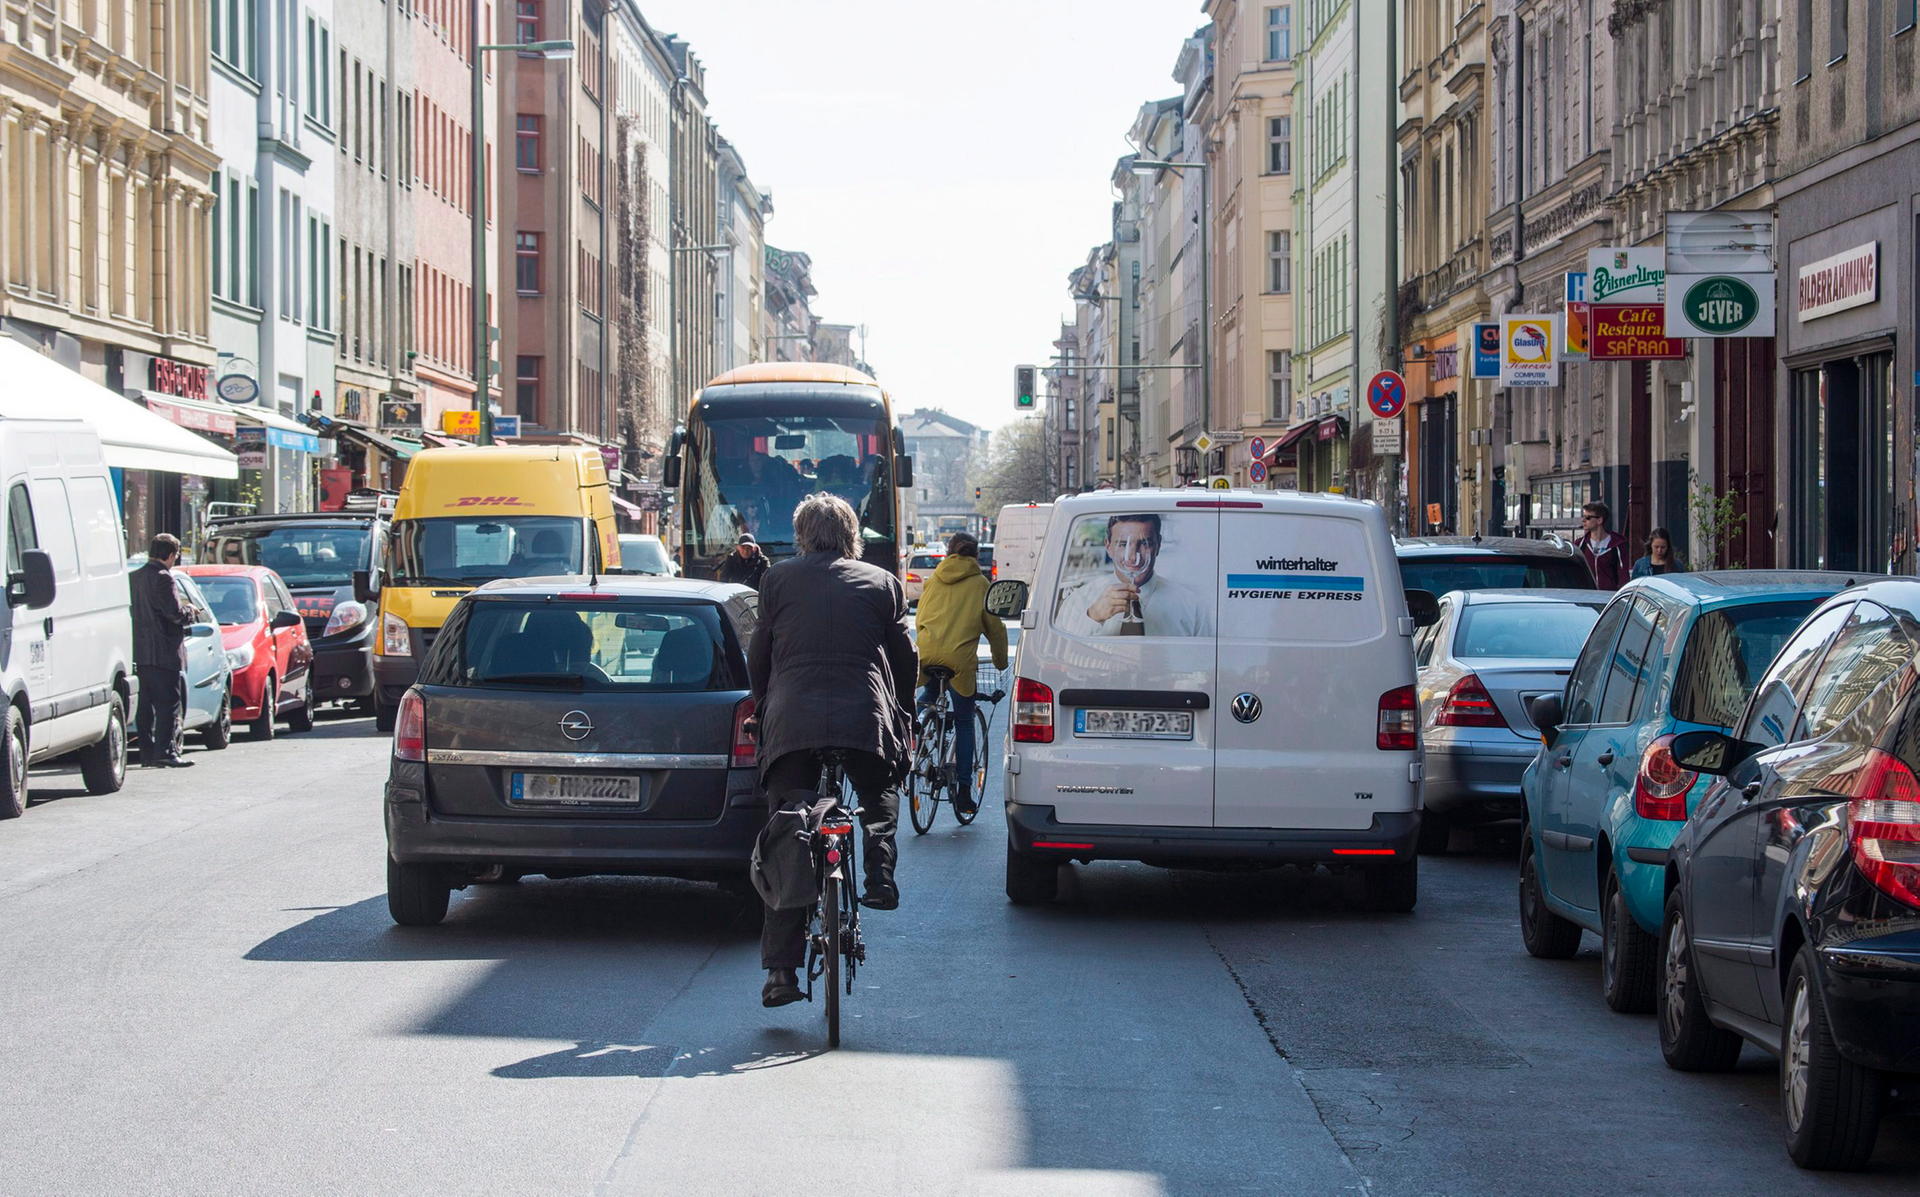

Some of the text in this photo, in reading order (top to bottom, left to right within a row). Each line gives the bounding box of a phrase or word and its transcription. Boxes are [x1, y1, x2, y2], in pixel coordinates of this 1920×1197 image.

[1593, 266, 1637, 302] Pilsner
[1799, 252, 1874, 312] BILDERRAHMUNG
[1618, 309, 1656, 323] Cafe
[1698, 299, 1743, 325] JEVER
[1597, 322, 1665, 337] Restaura
[182, 364, 209, 400] HOUSE
[453, 427, 478, 435] LOTTO
[457, 496, 523, 507] DHL
[1256, 555, 1339, 572] winterhalter
[1228, 590, 1363, 602] HYGIENE EXPRESS
[1056, 784, 1134, 795] TRANSPORTER
[1353, 791, 1374, 800] TDI
